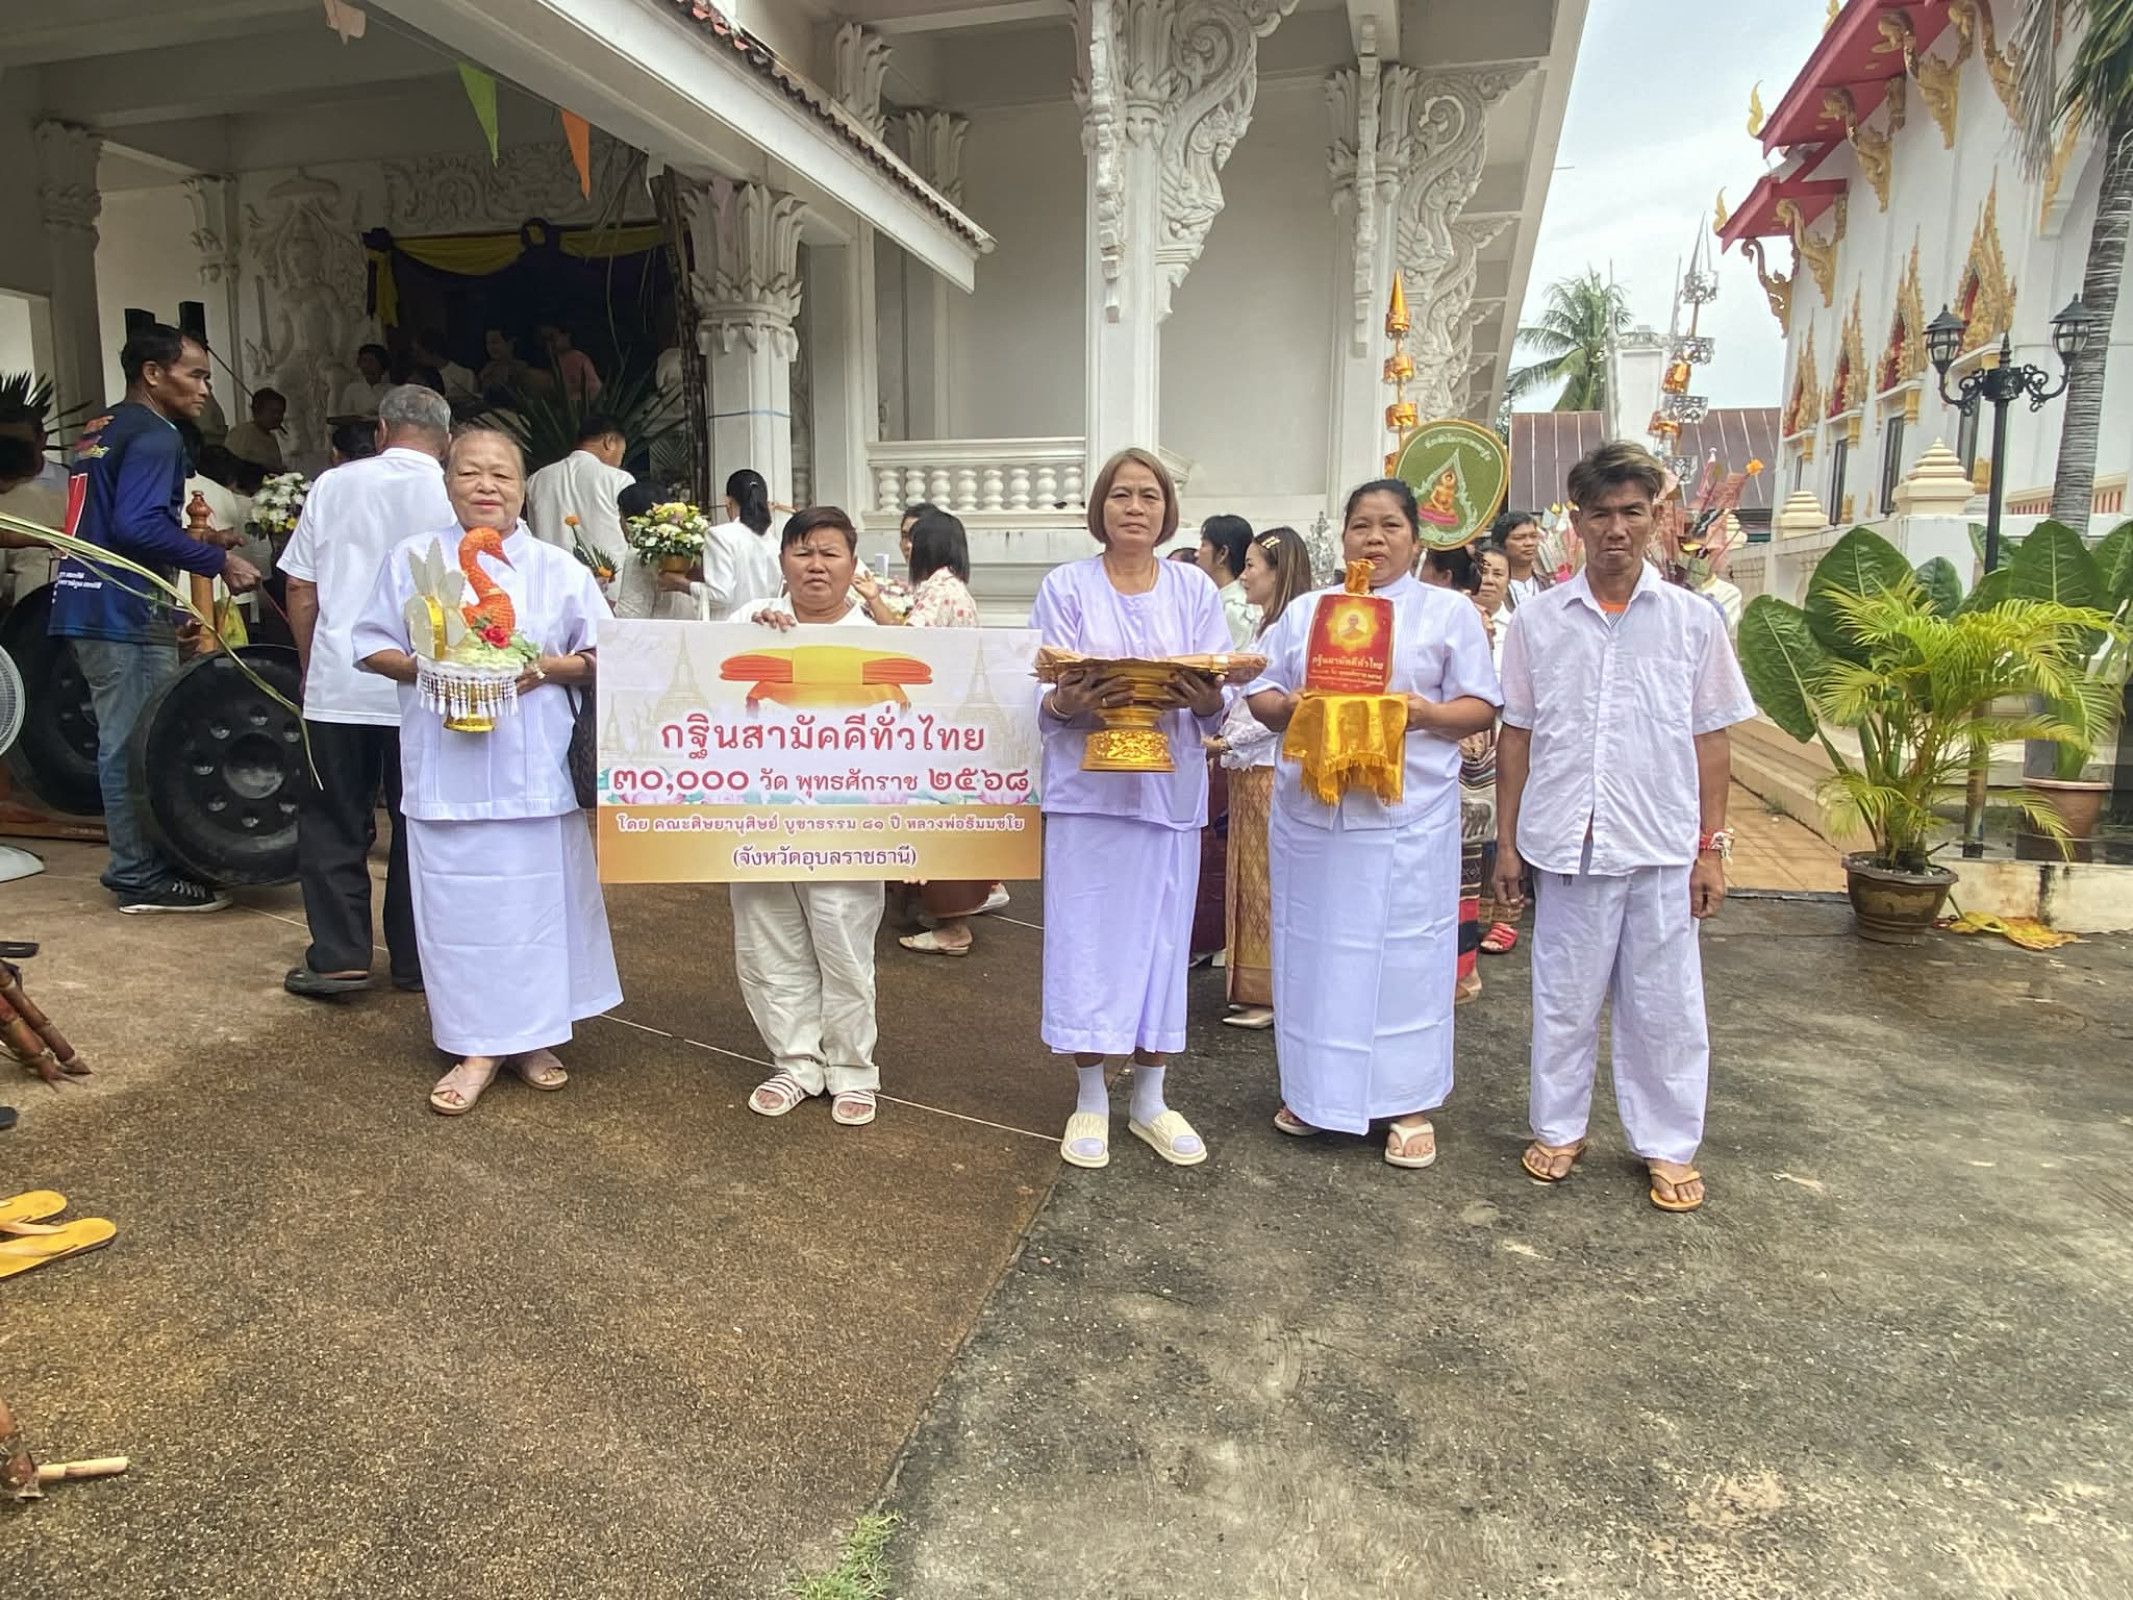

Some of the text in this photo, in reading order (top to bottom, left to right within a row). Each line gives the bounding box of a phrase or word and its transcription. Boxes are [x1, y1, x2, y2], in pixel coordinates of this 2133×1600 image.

[661, 705, 984, 760] กฐินสามัคคีทั่วไทย
[613, 767, 1029, 799] ๓๐,๐๐๐ วัด พุทธศักราช ๒๕๖๘
[617, 815, 648, 830] โดย
[654, 814, 778, 833] คณะศิษยานุศิษย์
[785, 818, 856, 834] บูชาธรรม
[891, 815, 901, 830] ปี
[733, 845, 917, 871] (จังหวัดอุบลราชธานี)
